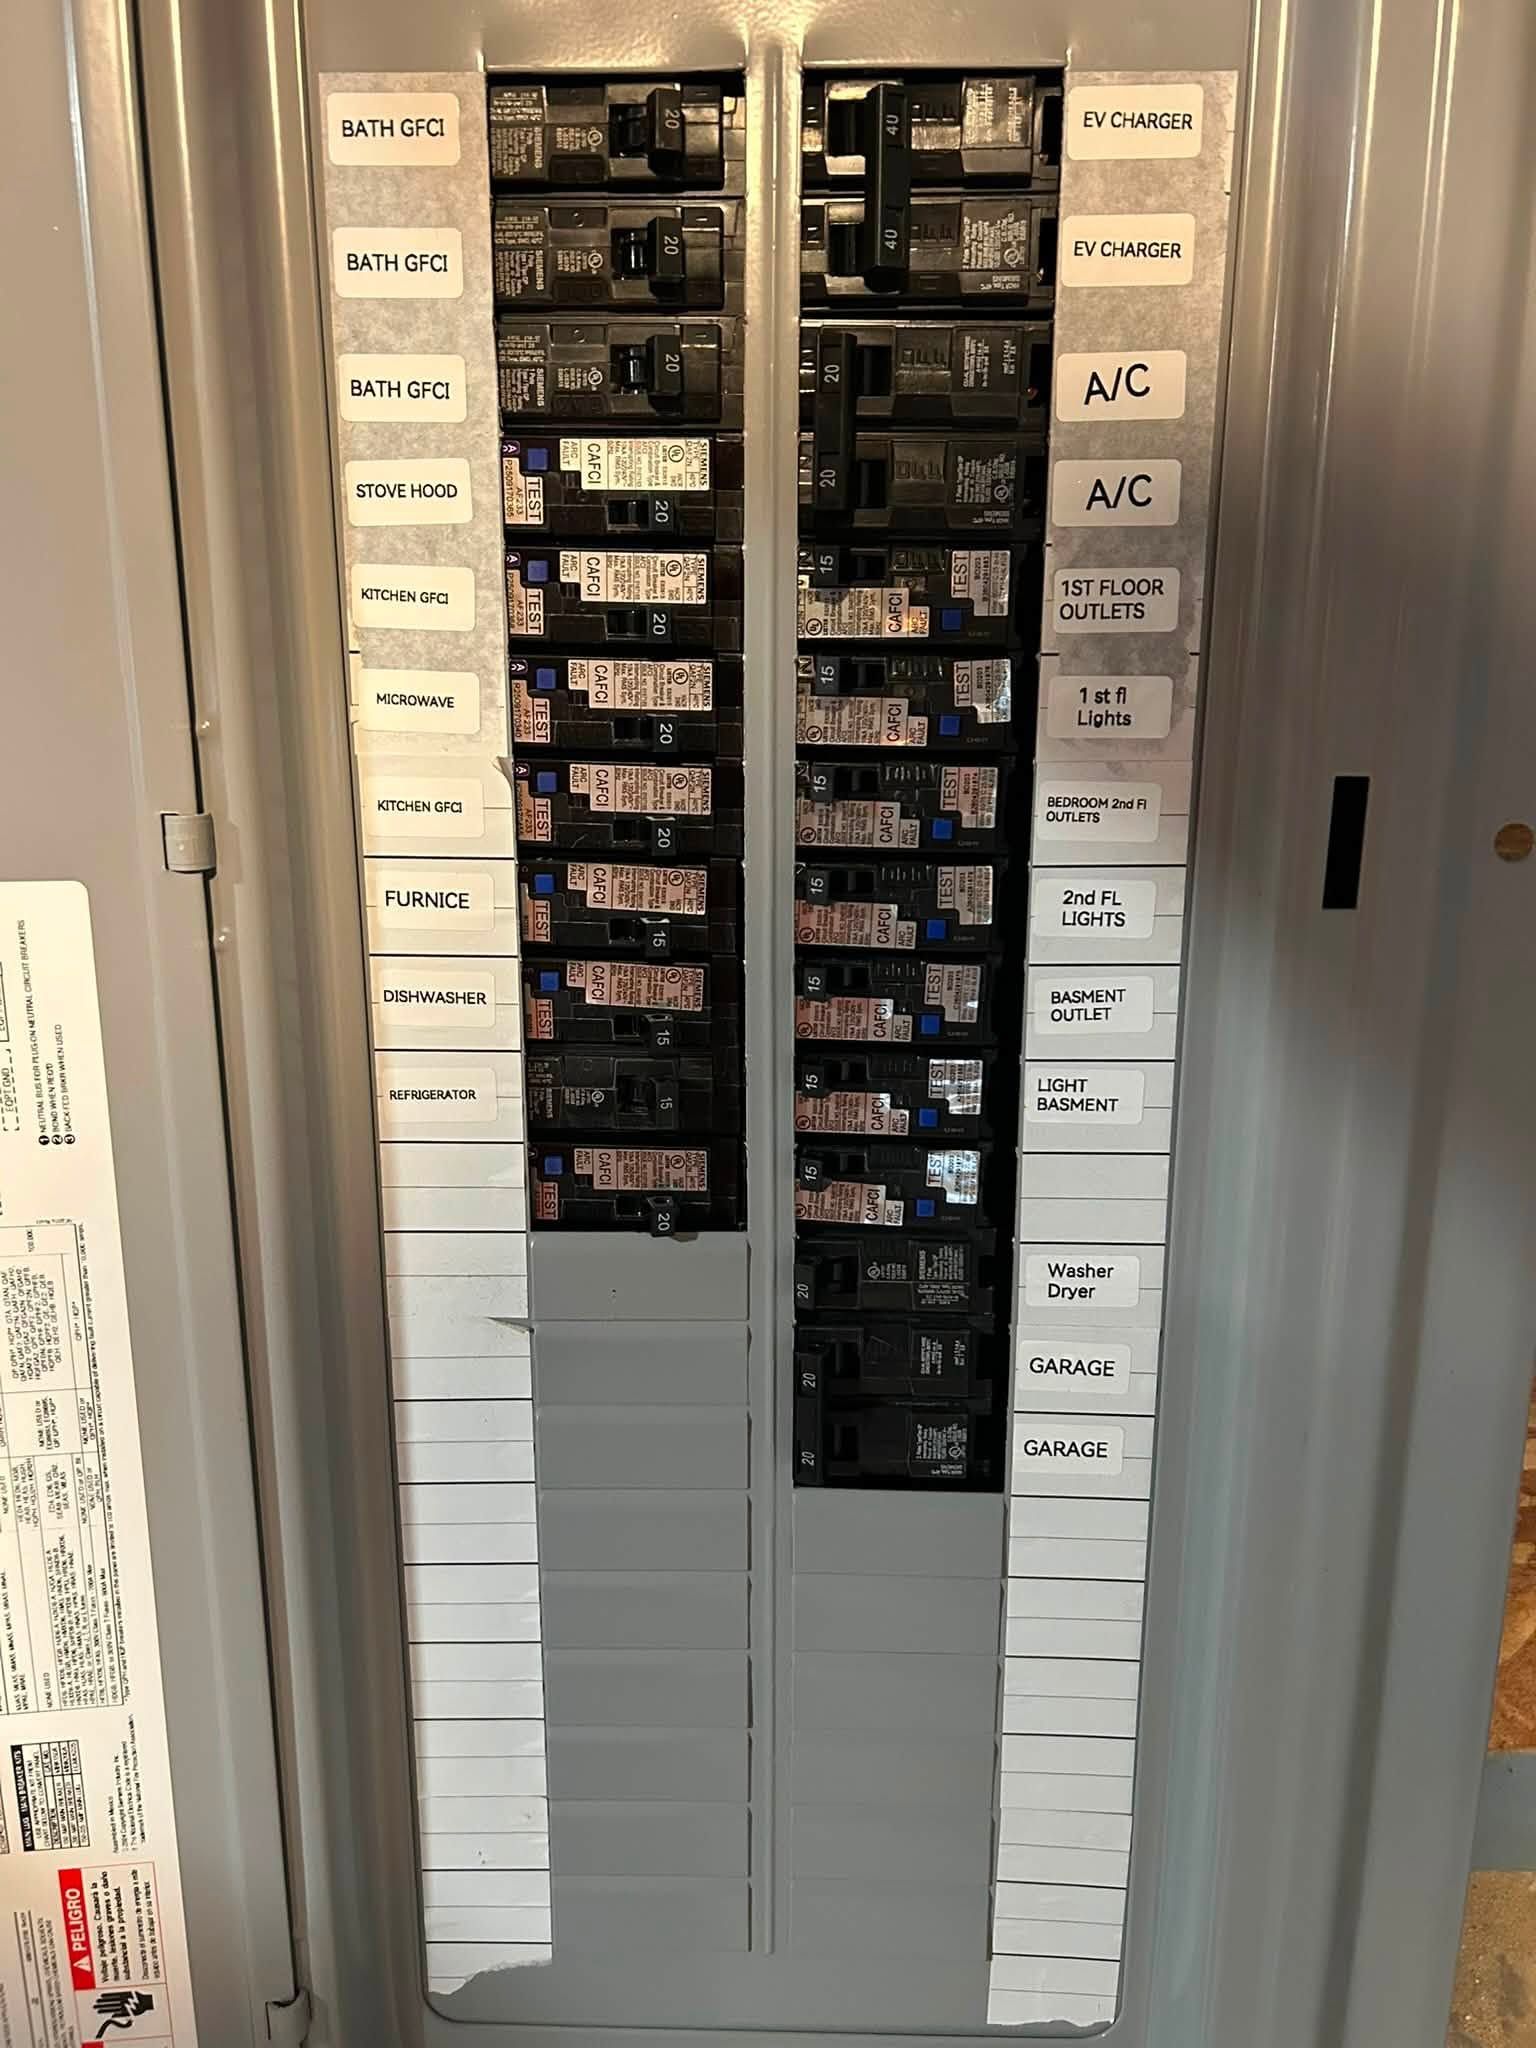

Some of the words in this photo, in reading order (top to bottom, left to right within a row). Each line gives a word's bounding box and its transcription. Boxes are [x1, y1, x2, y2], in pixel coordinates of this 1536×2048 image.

[341, 119, 395, 138] BATH
[400, 117, 445, 138] GFCI
[665, 109, 680, 129] 20
[885, 114, 899, 136] 40
[1083, 111, 1107, 129] EV
[1110, 111, 1193, 130] CHARGER
[664, 235, 679, 255] 20
[884, 229, 898, 250] 40
[1073, 240, 1097, 257] EV
[1100, 240, 1182, 259] CHARGER
[346, 252, 399, 272] BATH
[404, 253, 448, 273] GFCI
[665, 353, 680, 373] 20
[824, 364, 840, 383] 20
[350, 379, 401, 399] BATH
[407, 380, 450, 400] GFCI
[1083, 363, 1151, 406] A/C
[588, 443, 600, 484] CAFCI
[820, 469, 836, 488] 20
[356, 483, 407, 499] STOVE
[410, 483, 458, 499] HOOD
[528, 478, 541, 521] TEST
[1085, 473, 1153, 511] A/C
[655, 500, 669, 523] 20
[820, 555, 833, 574] 15
[953, 553, 968, 594] TEST
[587, 556, 600, 596] CAFCI
[360, 587, 417, 603] KITCHEN
[419, 591, 449, 605] GFCI
[1061, 578, 1095, 597] 1ST
[1099, 578, 1165, 597] FLOOR
[528, 591, 542, 633] TEST
[888, 592, 903, 633] CAFCI
[1059, 601, 1145, 621] OUTLETS
[653, 613, 666, 635] 20
[570, 662, 578, 686] FAULT
[594, 665, 608, 704] CAFCI
[820, 665, 834, 684] 15
[956, 664, 970, 704] TEST
[376, 692, 455, 709] MICROWAVE
[1079, 687, 1088, 705] 1
[1093, 687, 1111, 705] st
[535, 701, 548, 741] TEST
[886, 703, 902, 741] CAFCI
[1077, 709, 1132, 729] Lights
[660, 723, 673, 745] 20
[571, 766, 579, 789] FAULT
[579, 767, 587, 783] ARC
[813, 775, 827, 792] 15
[595, 769, 608, 807] CAFCI
[702, 769, 710, 812] SIEMENS
[943, 768, 957, 808] TEST
[377, 799, 431, 813] KITCHEN
[434, 801, 463, 814] GFCI
[1047, 796, 1109, 809] BEDROOM
[1111, 798, 1135, 810] 2nd
[536, 801, 549, 840] TEST
[879, 806, 894, 843] CAFCI
[1045, 810, 1101, 824] OUTLETS
[657, 827, 671, 848] 20
[569, 864, 577, 886] FAULT
[577, 864, 585, 880] ARC
[592, 867, 606, 904] CAFCI
[697, 871, 705, 912] SIEMENS
[810, 877, 824, 895] 15
[939, 869, 953, 907] TEST
[385, 890, 470, 910] FURNICE
[1062, 889, 1096, 906] 2nd
[1100, 890, 1122, 906] FL
[535, 903, 549, 941] TEST
[877, 908, 891, 944] CAFCI
[1061, 910, 1126, 928] LIGHTS
[653, 930, 666, 948] 15
[591, 965, 605, 1001] CAFCI
[695, 968, 703, 1009] SIEMENS
[808, 976, 821, 992] 15
[927, 966, 942, 1002] TEST
[383, 989, 487, 1005] DISHWASHER
[1050, 988, 1127, 1005] BASMENT
[538, 1001, 552, 1038] TEST
[873, 1003, 887, 1038] CAFCI
[1050, 1007, 1112, 1023] OUTLET
[657, 1029, 670, 1046] 15
[805, 1074, 818, 1090] 15
[930, 1061, 944, 1096] TEST
[1037, 1078, 1089, 1093] LIGHT
[389, 1089, 477, 1101] REFRIGERATOR
[660, 1096, 673, 1110] 15
[1036, 1096, 1119, 1112] BASMENT
[871, 1097, 885, 1131] CAFCI
[599, 1152, 611, 1185] CAFCI
[804, 1165, 817, 1181] 15
[544, 1184, 557, 1218] TEST
[865, 1189, 880, 1221] CAFCI
[658, 1213, 671, 1231] 20
[1047, 1262, 1115, 1279] Washer
[797, 1283, 808, 1299] 20
[1047, 1282, 1096, 1301] Dryer
[1029, 1356, 1116, 1377] GARAGE
[802, 1372, 816, 1388] 20
[801, 1451, 815, 1466] 20
[1023, 1439, 1109, 1459] GARAGE
[65, 1888, 87, 1951] PELIGRO
